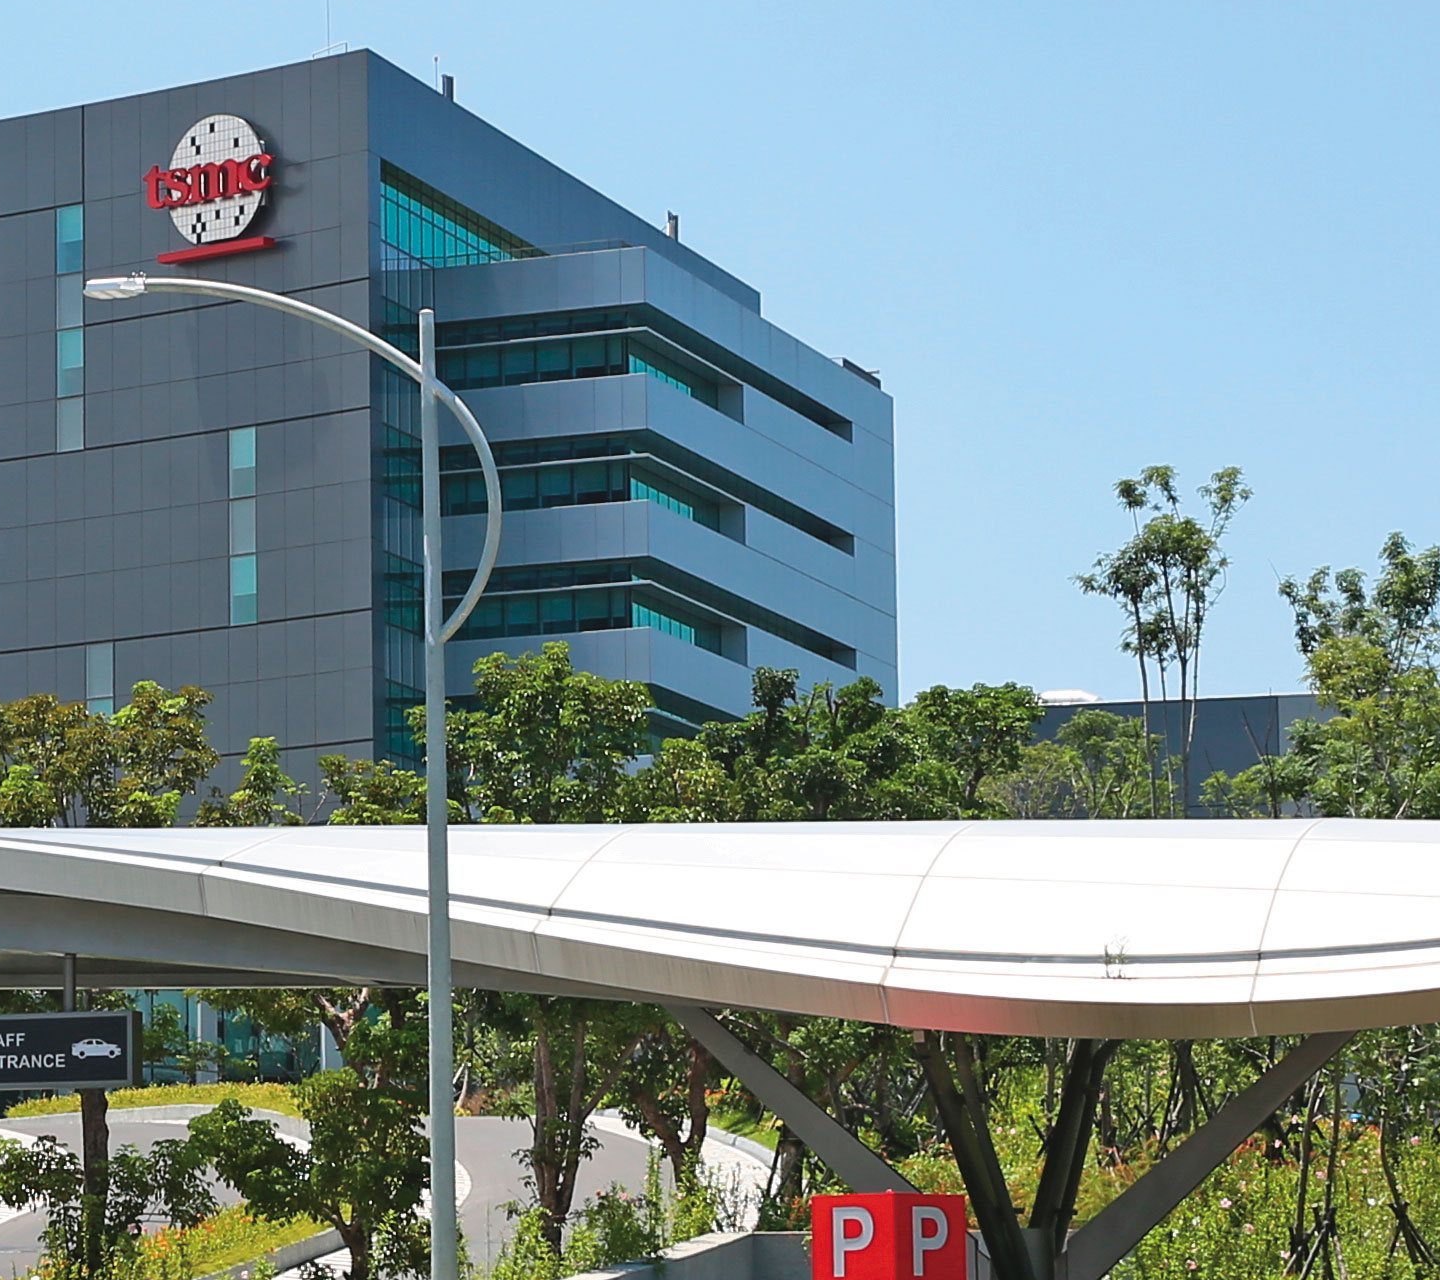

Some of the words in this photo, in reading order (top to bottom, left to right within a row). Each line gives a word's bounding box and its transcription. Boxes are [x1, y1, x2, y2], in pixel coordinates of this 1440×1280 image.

[143, 153, 273, 209] tsmc
[832, 1206, 874, 1277] P
[912, 1206, 948, 1276] P
